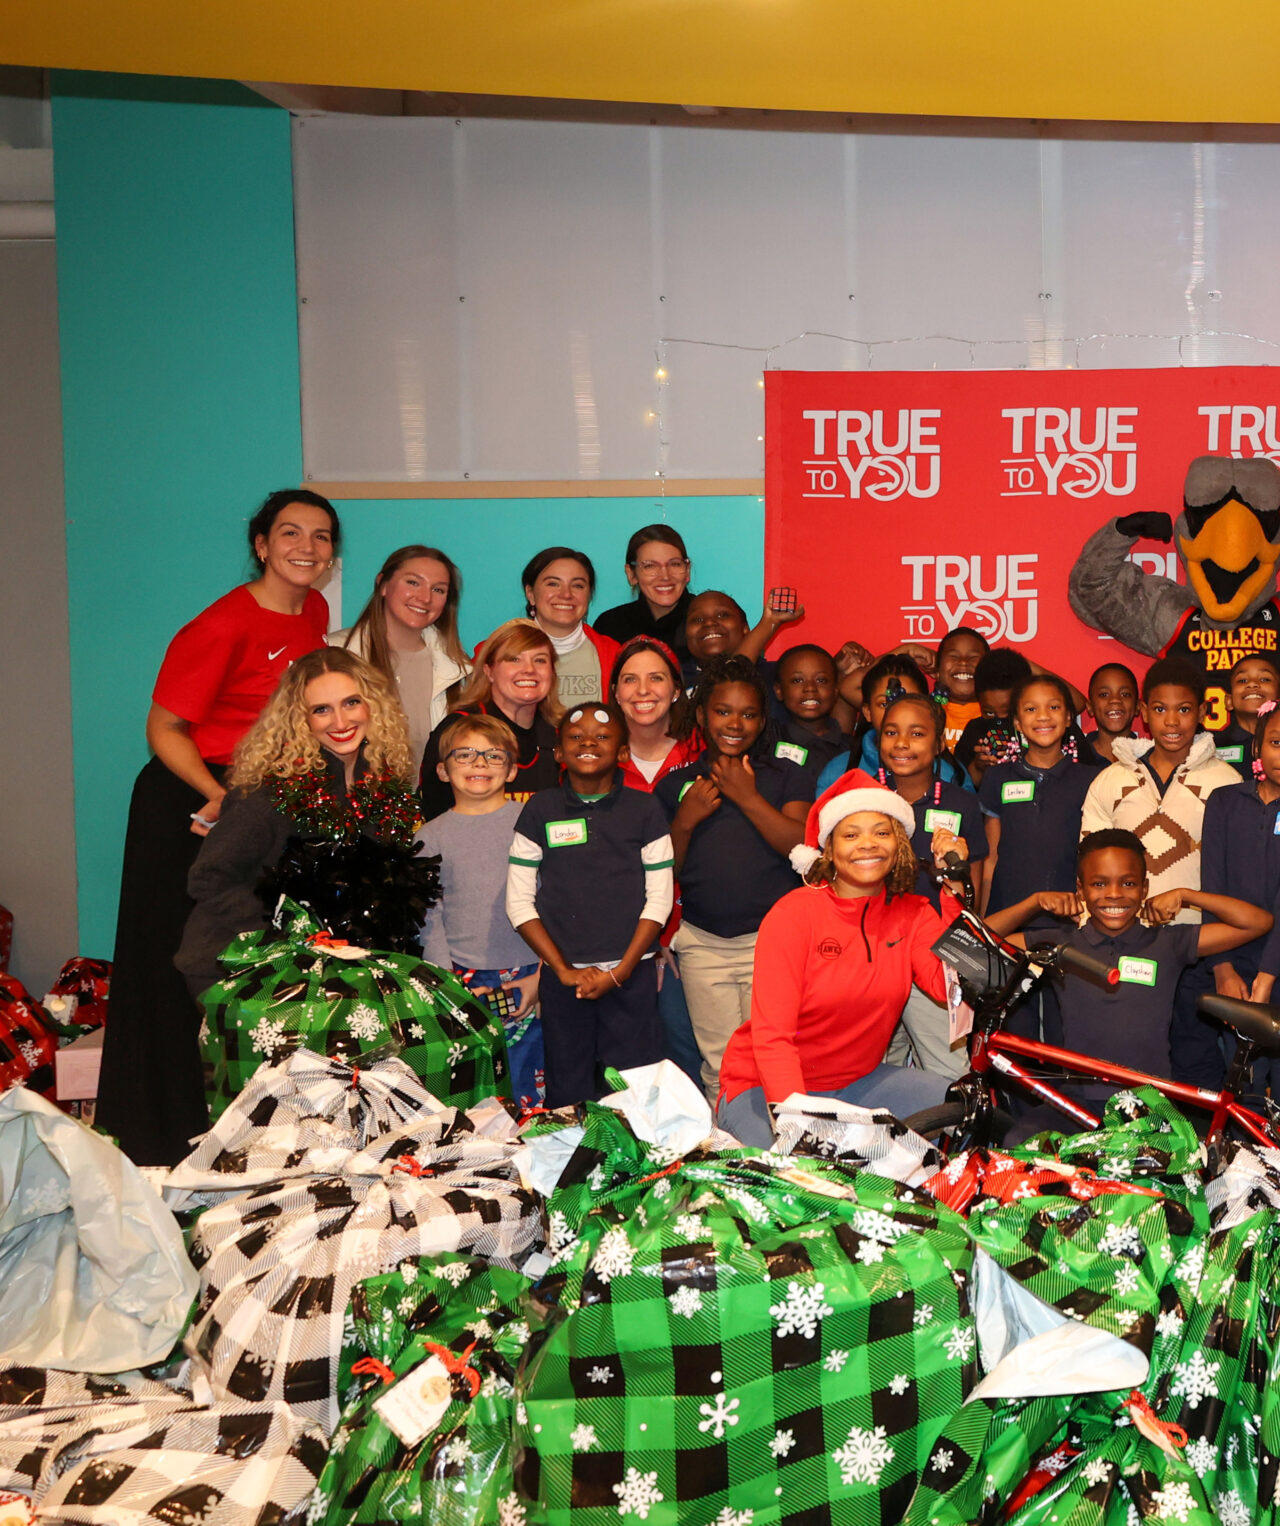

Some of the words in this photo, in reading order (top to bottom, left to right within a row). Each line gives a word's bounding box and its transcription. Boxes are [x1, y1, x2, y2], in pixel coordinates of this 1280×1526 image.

[803, 409, 941, 455] TRUE
[1001, 407, 1138, 453] TRUE
[806, 470, 836, 490] TO
[838, 455, 941, 501] YOU
[1004, 468, 1034, 488] TO
[1036, 453, 1136, 499] YOU
[901, 554, 1038, 600] TRUE
[904, 614, 934, 636] TO
[1187, 627, 1277, 652] COLLEGE
[1206, 648, 1260, 671] PAR
